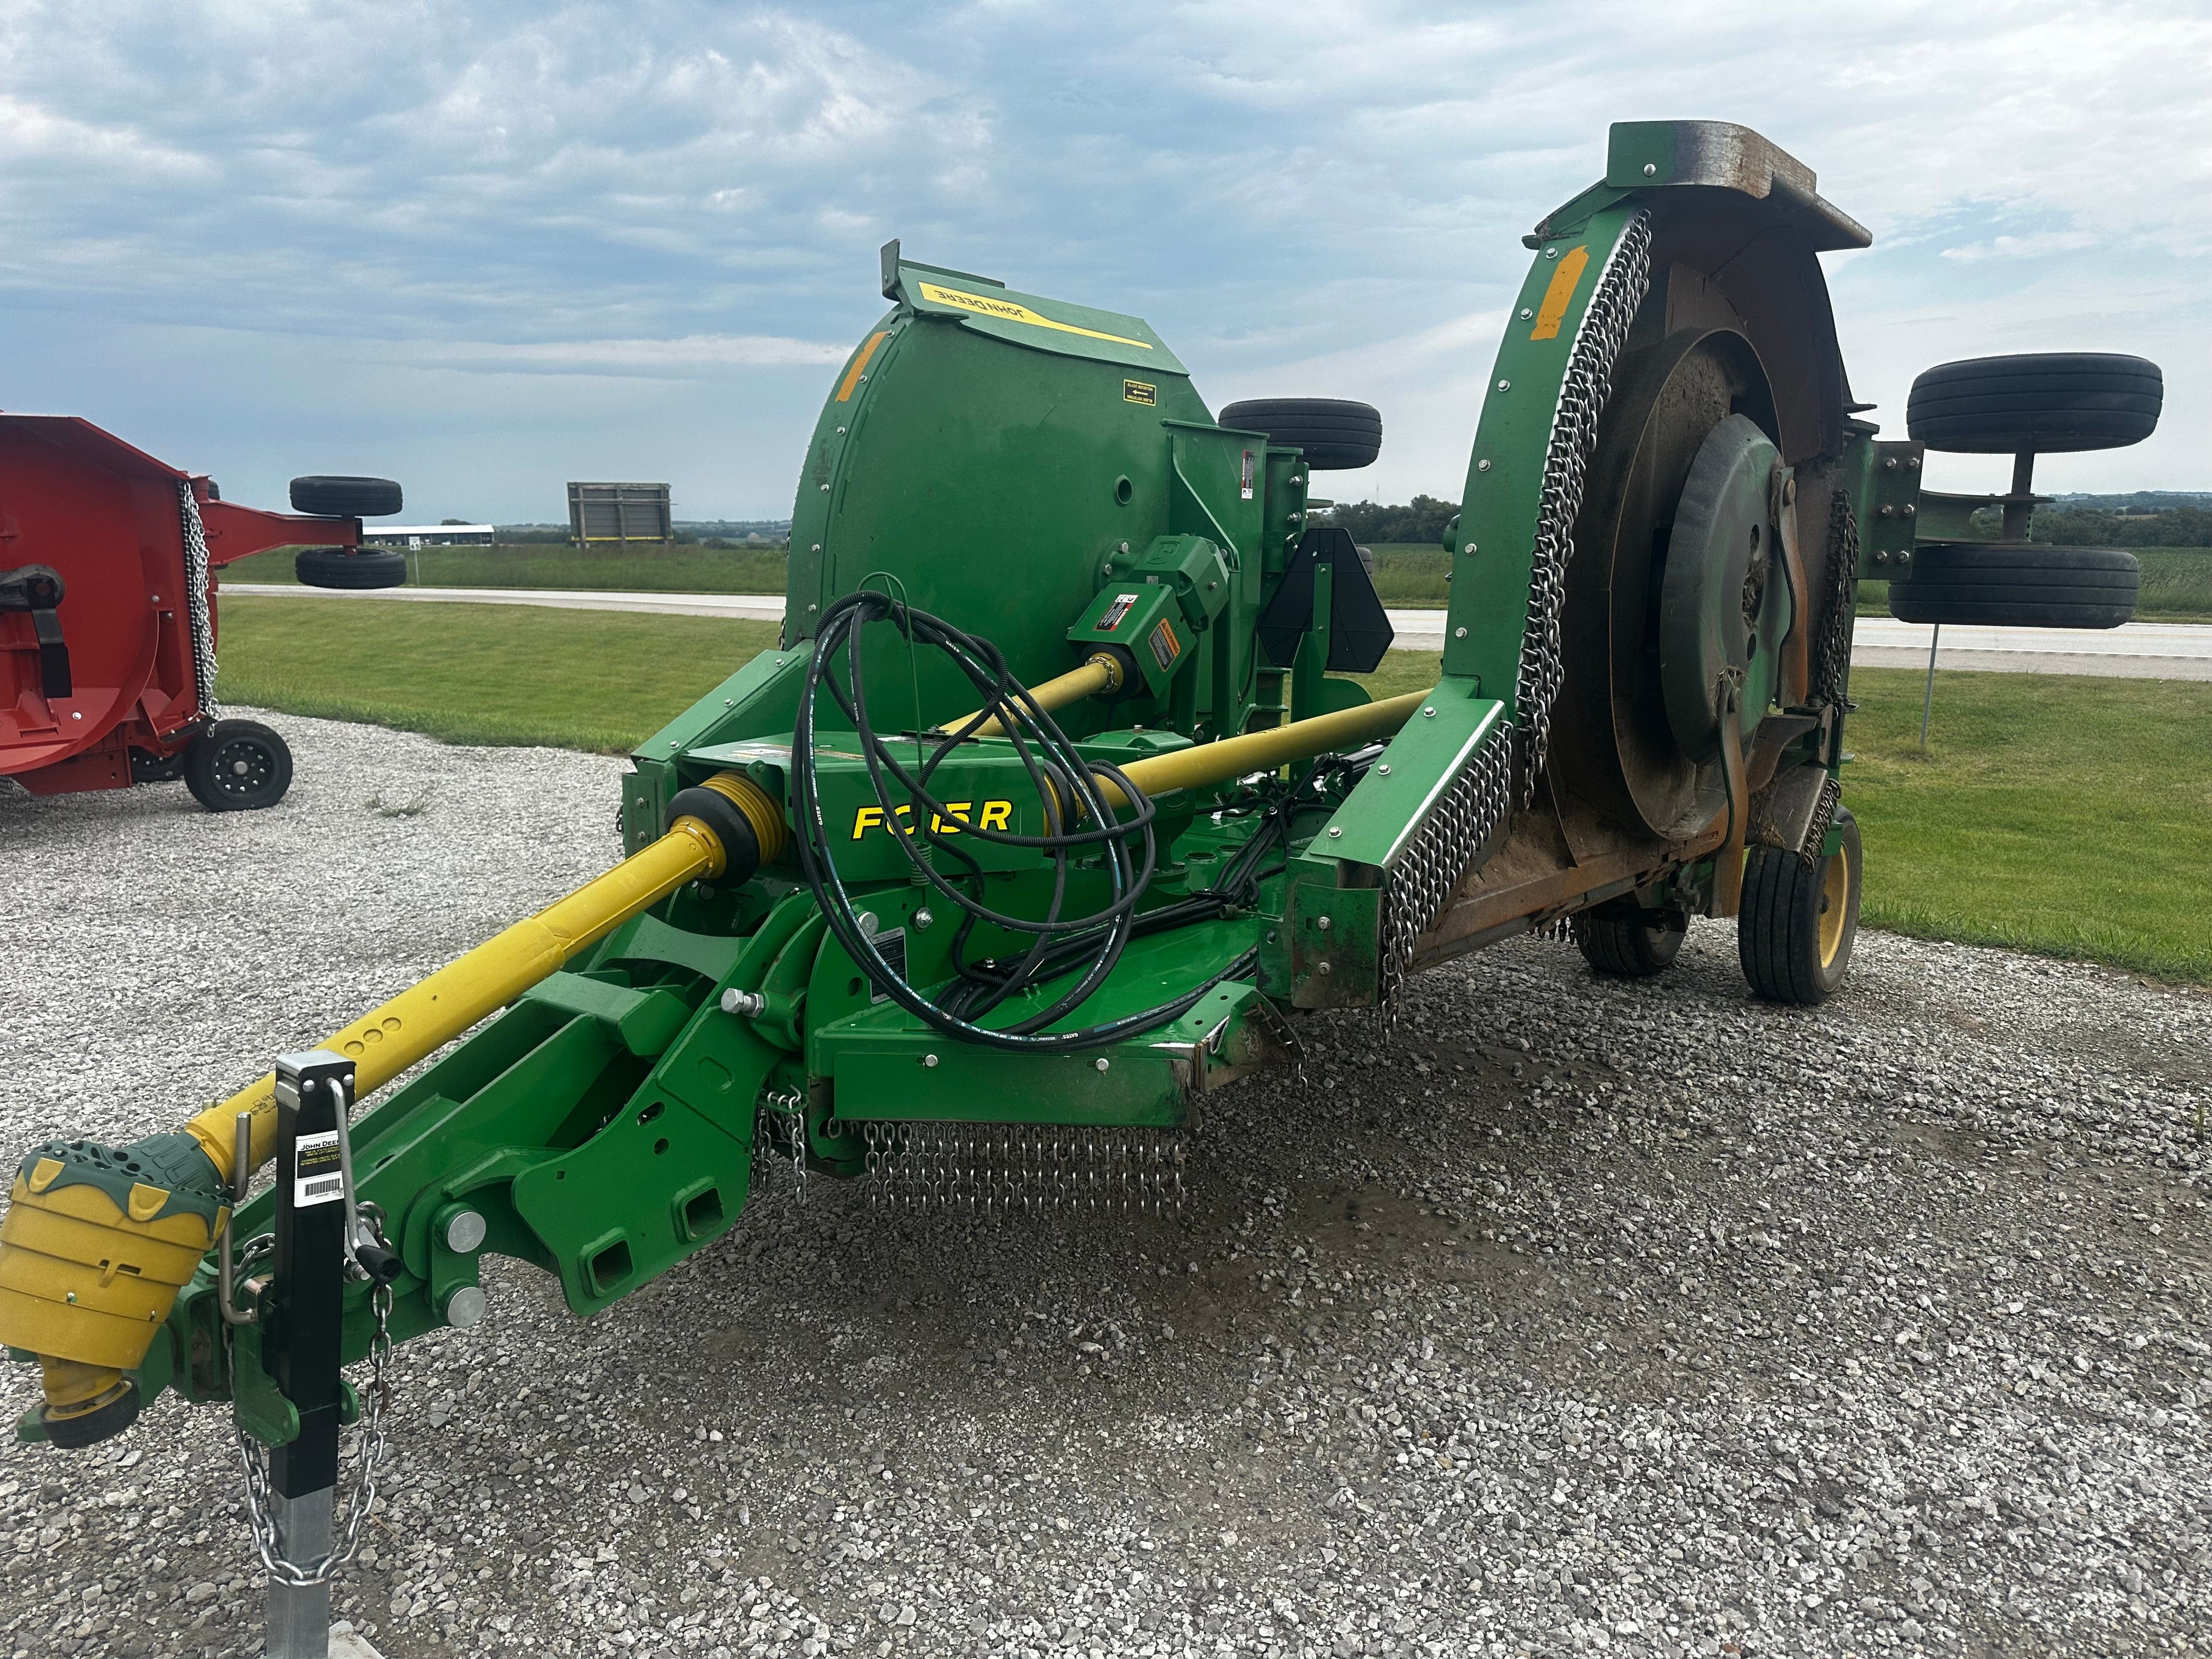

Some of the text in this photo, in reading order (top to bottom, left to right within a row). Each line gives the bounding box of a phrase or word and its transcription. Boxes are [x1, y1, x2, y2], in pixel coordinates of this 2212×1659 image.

[934, 290, 1024, 318] JOHN DEERE
[1165, 628, 1179, 654] WARNING
